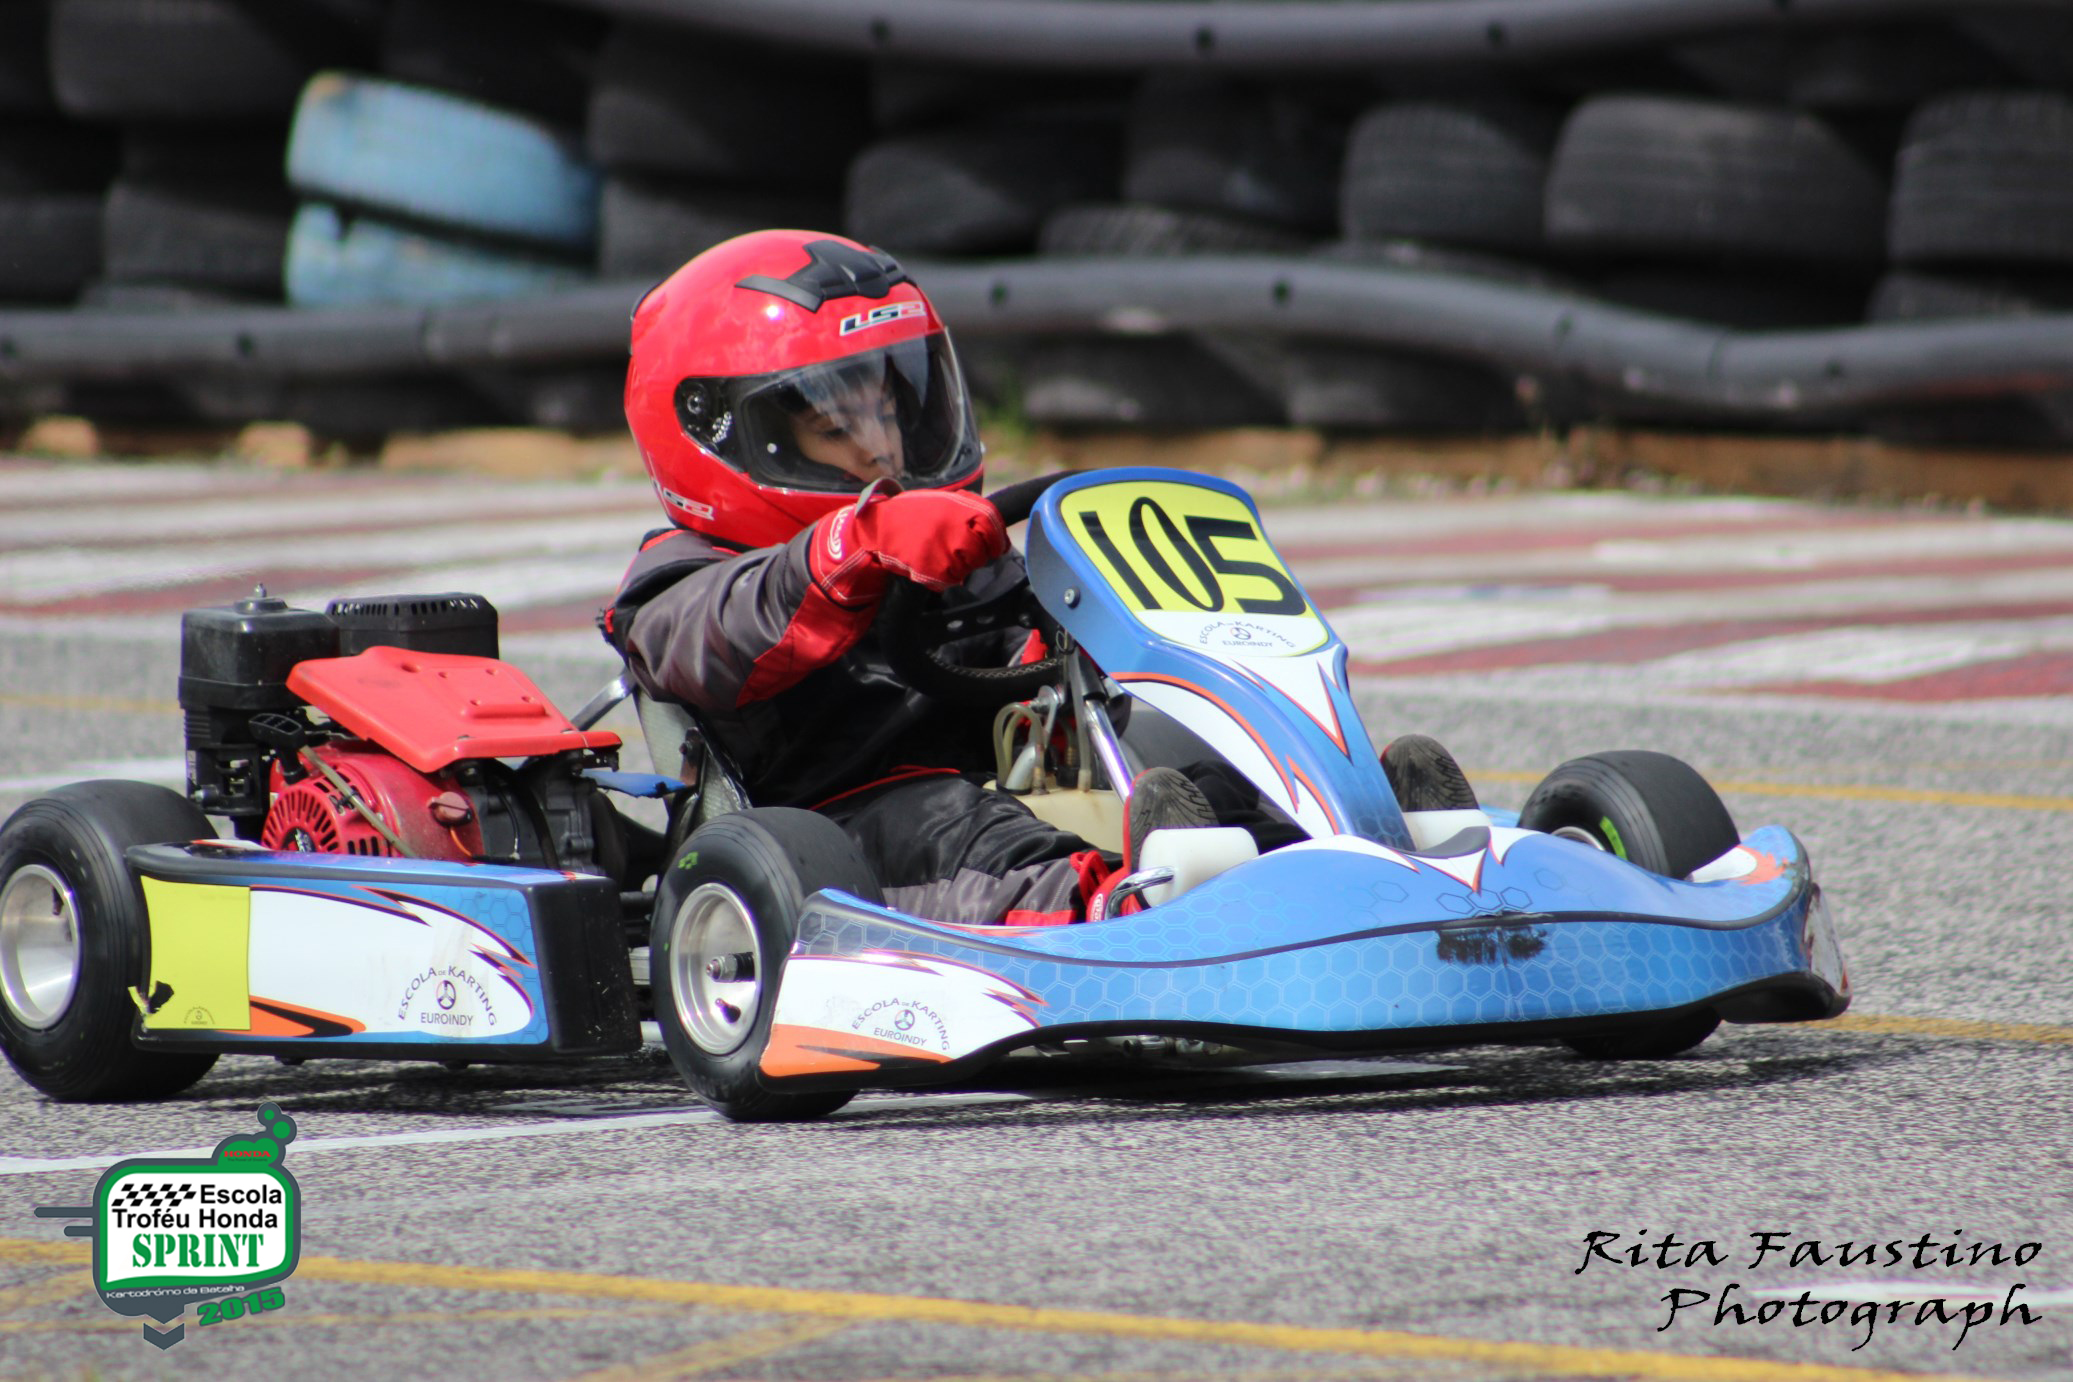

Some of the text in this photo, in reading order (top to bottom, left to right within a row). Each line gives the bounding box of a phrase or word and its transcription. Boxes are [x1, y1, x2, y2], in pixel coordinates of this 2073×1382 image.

[839, 301, 928, 336] LS2
[1078, 496, 1307, 616] 105
[1200, 621, 1226, 645] ESCOLA
[398, 966, 437, 1021] ESCOLA
[448, 965, 497, 1027] KARTING
[420, 1012, 474, 1027] EUROINDY
[852, 997, 900, 1030] ESCOLA
[911, 1000, 950, 1051] KARTING
[873, 1027, 928, 1047] EUROINDY
